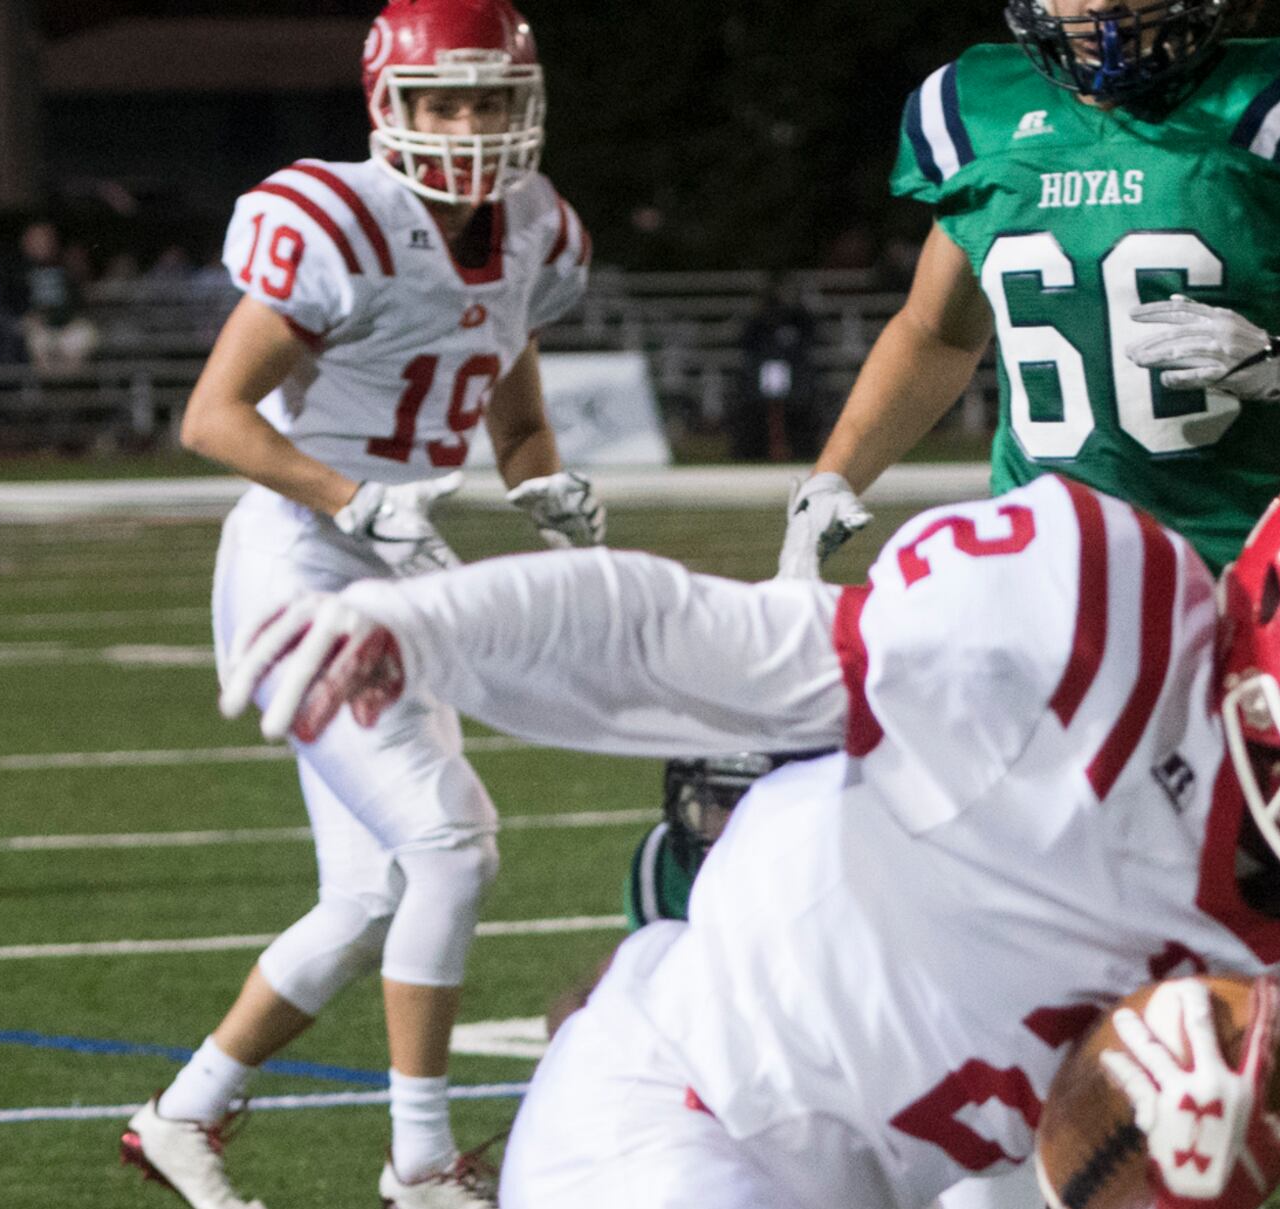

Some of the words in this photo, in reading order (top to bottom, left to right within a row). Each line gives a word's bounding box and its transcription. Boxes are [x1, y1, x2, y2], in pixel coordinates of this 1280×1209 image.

[1037, 169, 1144, 209] HOYAS
[239, 212, 305, 301] 19
[982, 231, 1242, 462] 66
[365, 354, 501, 467] 19
[897, 504, 1036, 588] 2
